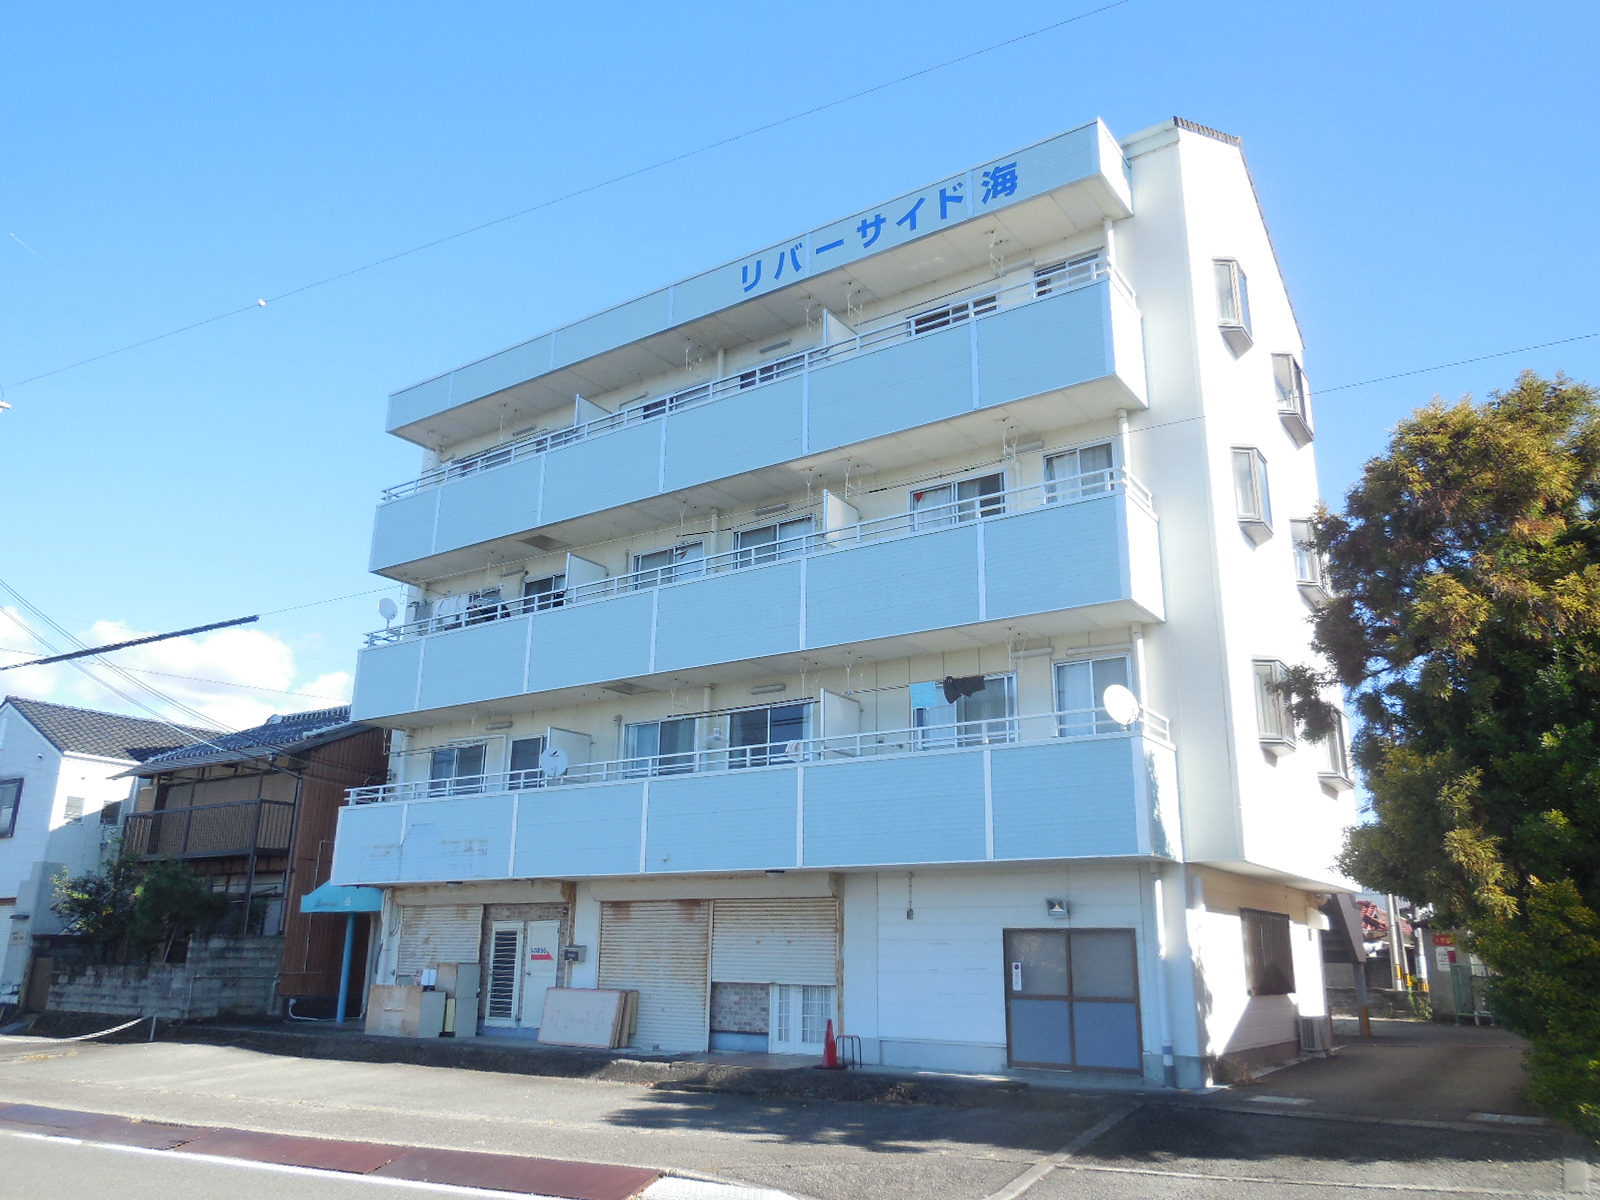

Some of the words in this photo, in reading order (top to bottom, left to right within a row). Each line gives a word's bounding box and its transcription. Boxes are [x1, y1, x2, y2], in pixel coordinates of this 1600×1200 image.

[741, 161, 1018, 292] リバーサイド海
